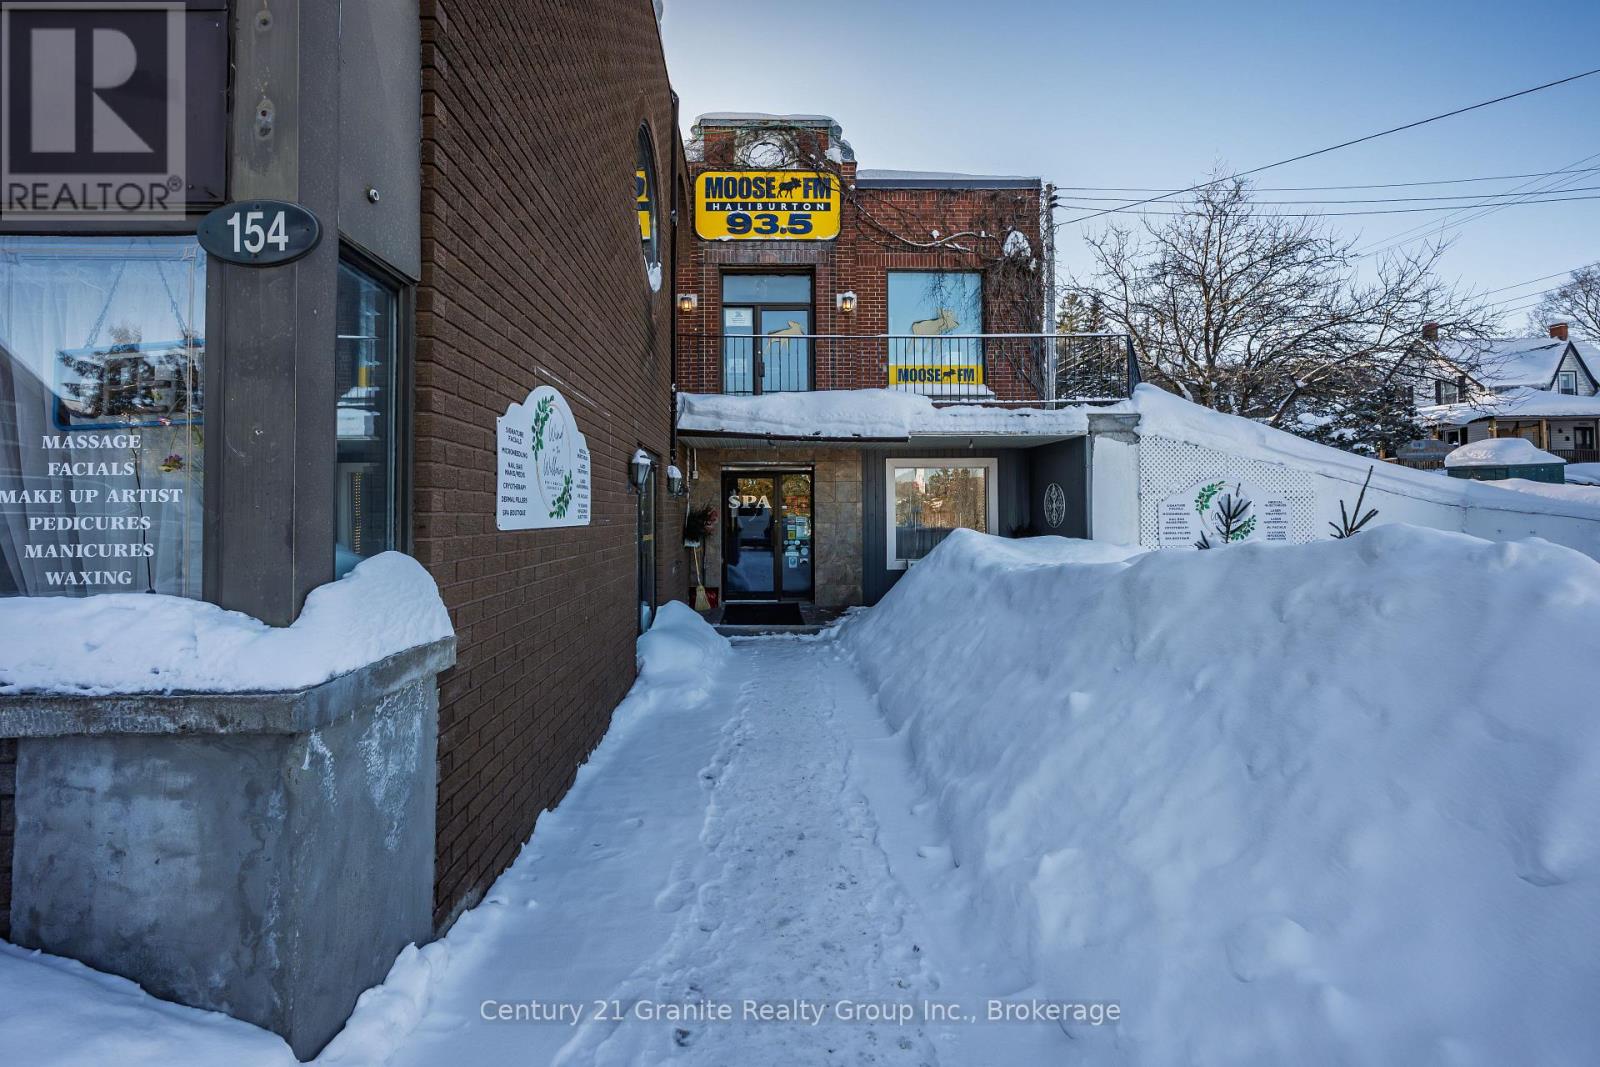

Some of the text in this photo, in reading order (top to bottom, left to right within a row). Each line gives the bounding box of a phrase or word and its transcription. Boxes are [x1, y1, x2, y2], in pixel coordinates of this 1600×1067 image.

[705, 176, 831, 199] MOOSE FM
[712, 203, 825, 211] HALIBURTON
[726, 213, 813, 234] 93.5
[227, 211, 288, 253] 154
[898, 368, 974, 382] MOOSE FM
[42, 435, 141, 449] MASSAGE
[48, 462, 135, 476] FACIALS
[0, 488, 183, 504] MAKE UP ARTIST
[728, 495, 772, 509] SPA
[28, 517, 151, 531] PEDICURES
[24, 544, 154, 558] MANICURES
[45, 571, 133, 585] WAXING
